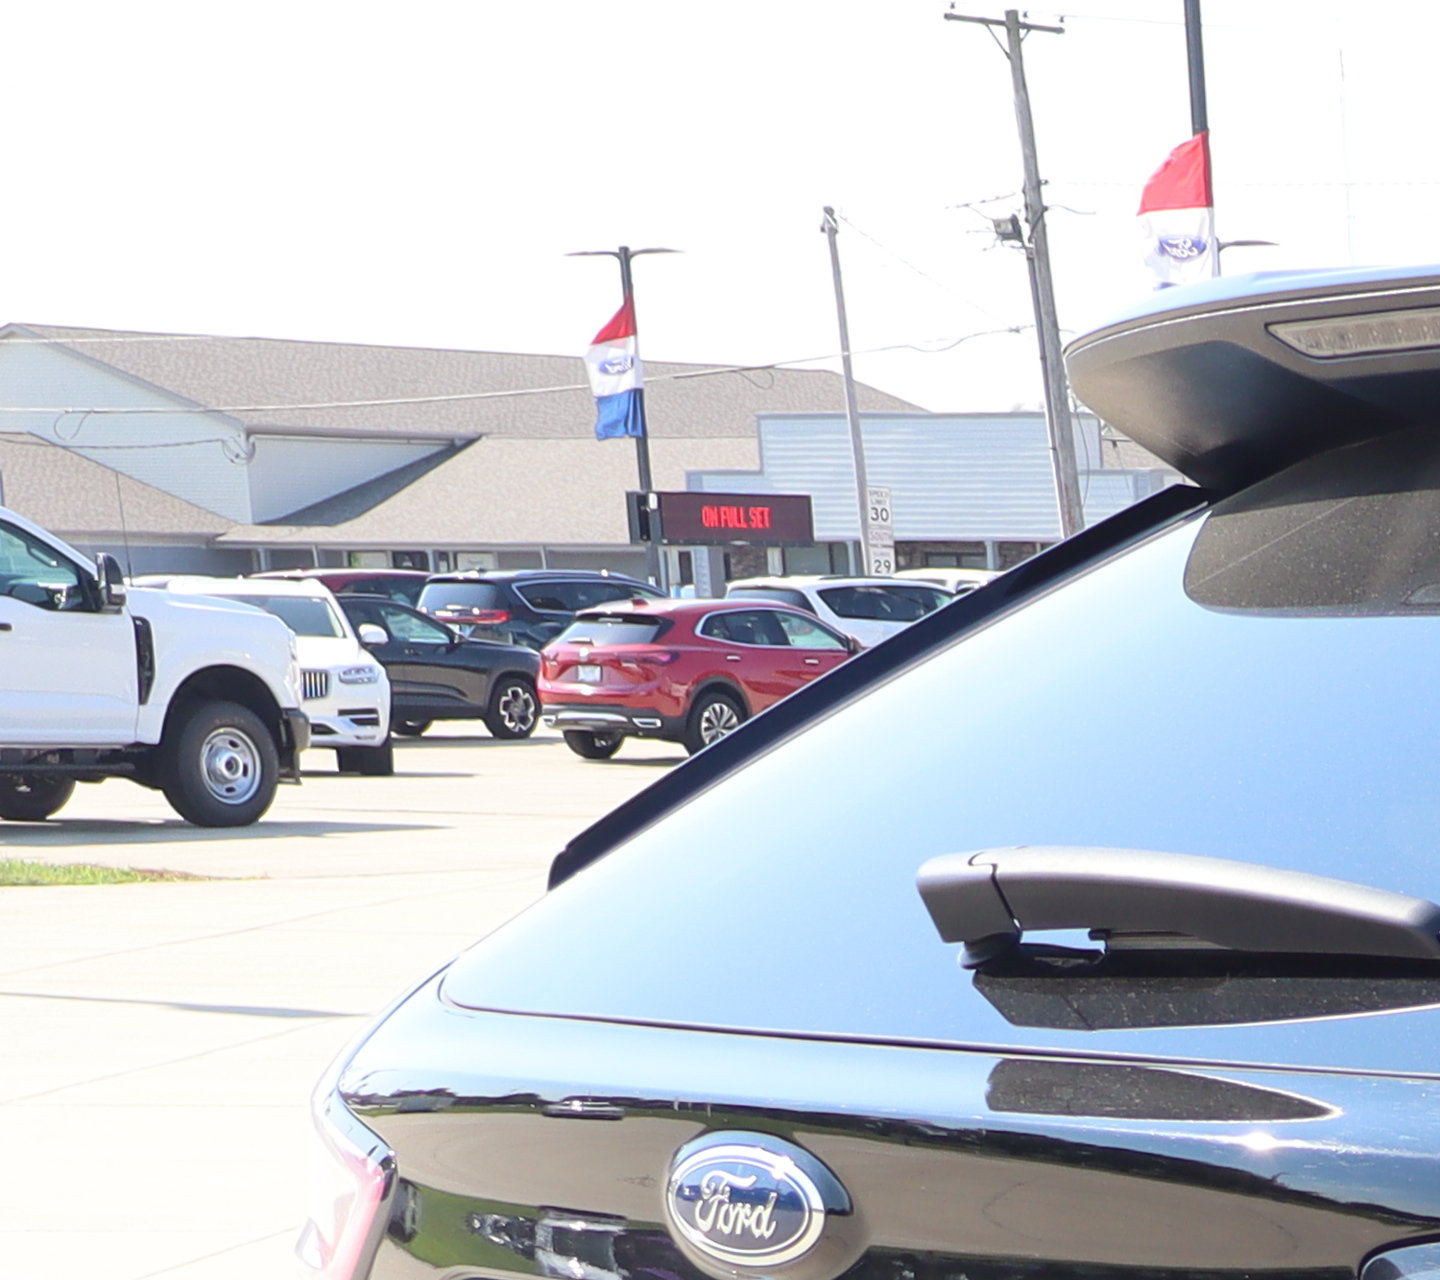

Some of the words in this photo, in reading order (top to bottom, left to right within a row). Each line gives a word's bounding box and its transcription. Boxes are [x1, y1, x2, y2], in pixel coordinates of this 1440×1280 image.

[720, 506, 747, 528] FULL
[749, 507, 769, 528] SET
[870, 507, 889, 522] 30
[874, 559, 891, 574] 29
[694, 1170, 778, 1239] Ford
